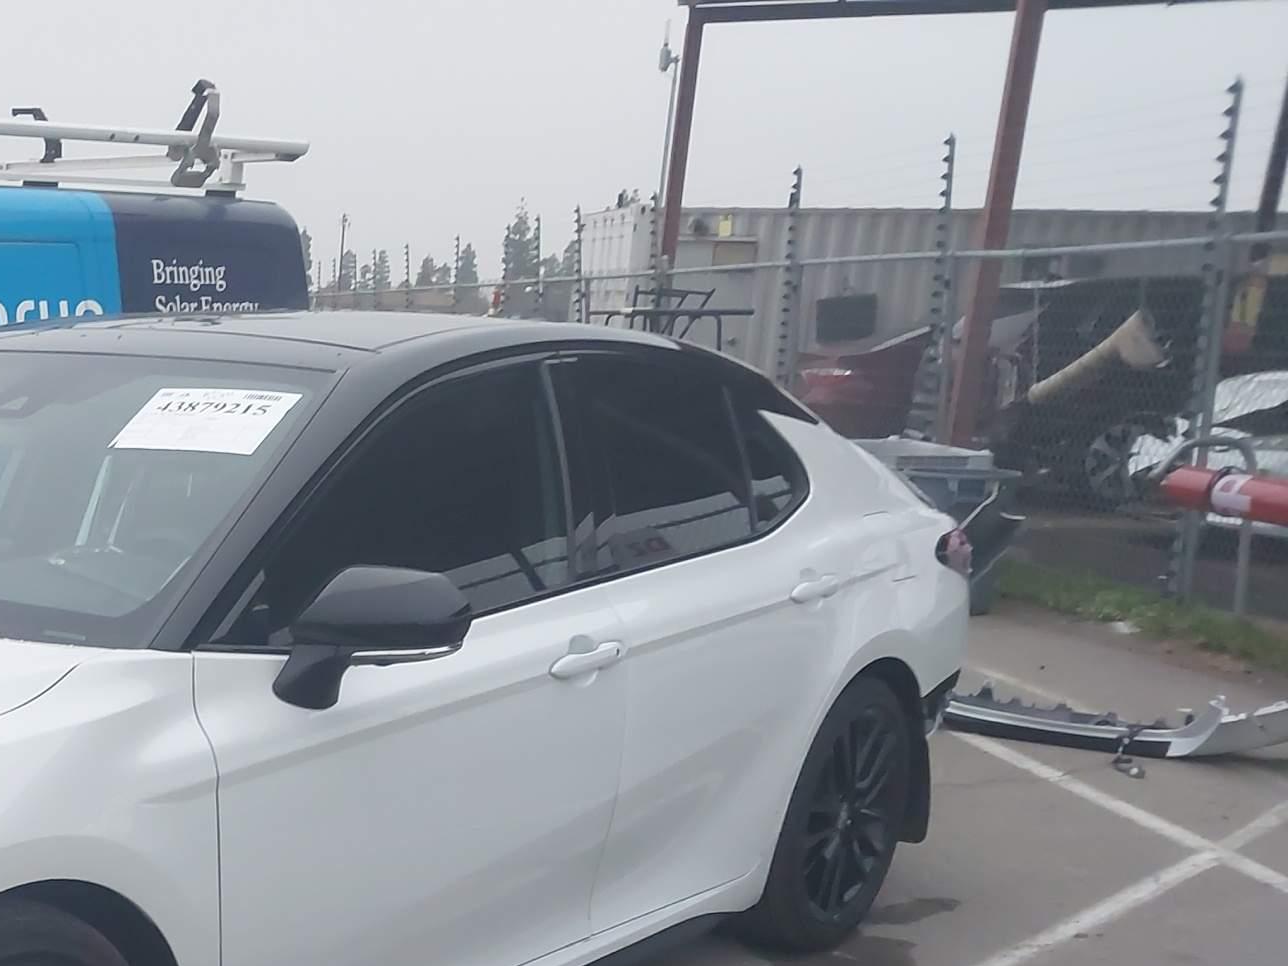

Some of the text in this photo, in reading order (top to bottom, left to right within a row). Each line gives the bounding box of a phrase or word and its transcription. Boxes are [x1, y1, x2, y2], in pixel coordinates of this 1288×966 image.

[151, 259, 227, 292] Bringing
[155, 295, 198, 313] Solar
[157, 401, 272, 416] 43879215
